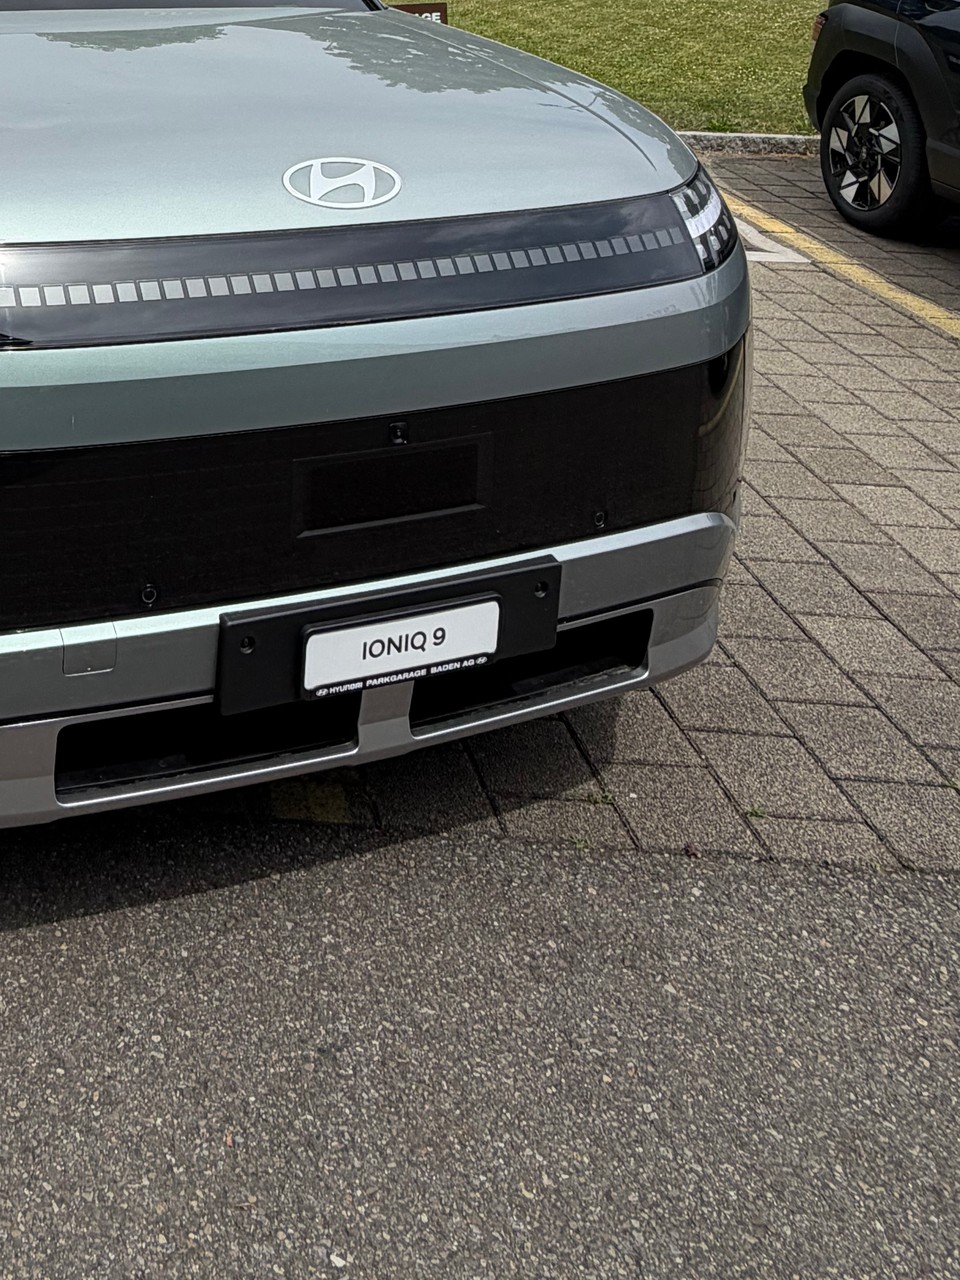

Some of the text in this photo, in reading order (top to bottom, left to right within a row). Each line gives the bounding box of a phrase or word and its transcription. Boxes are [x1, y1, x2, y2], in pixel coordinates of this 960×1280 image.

[362, 627, 446, 660] IONIQ 9
[329, 659, 475, 694] HYUNDAI PARKGARAGE BADEN AG
